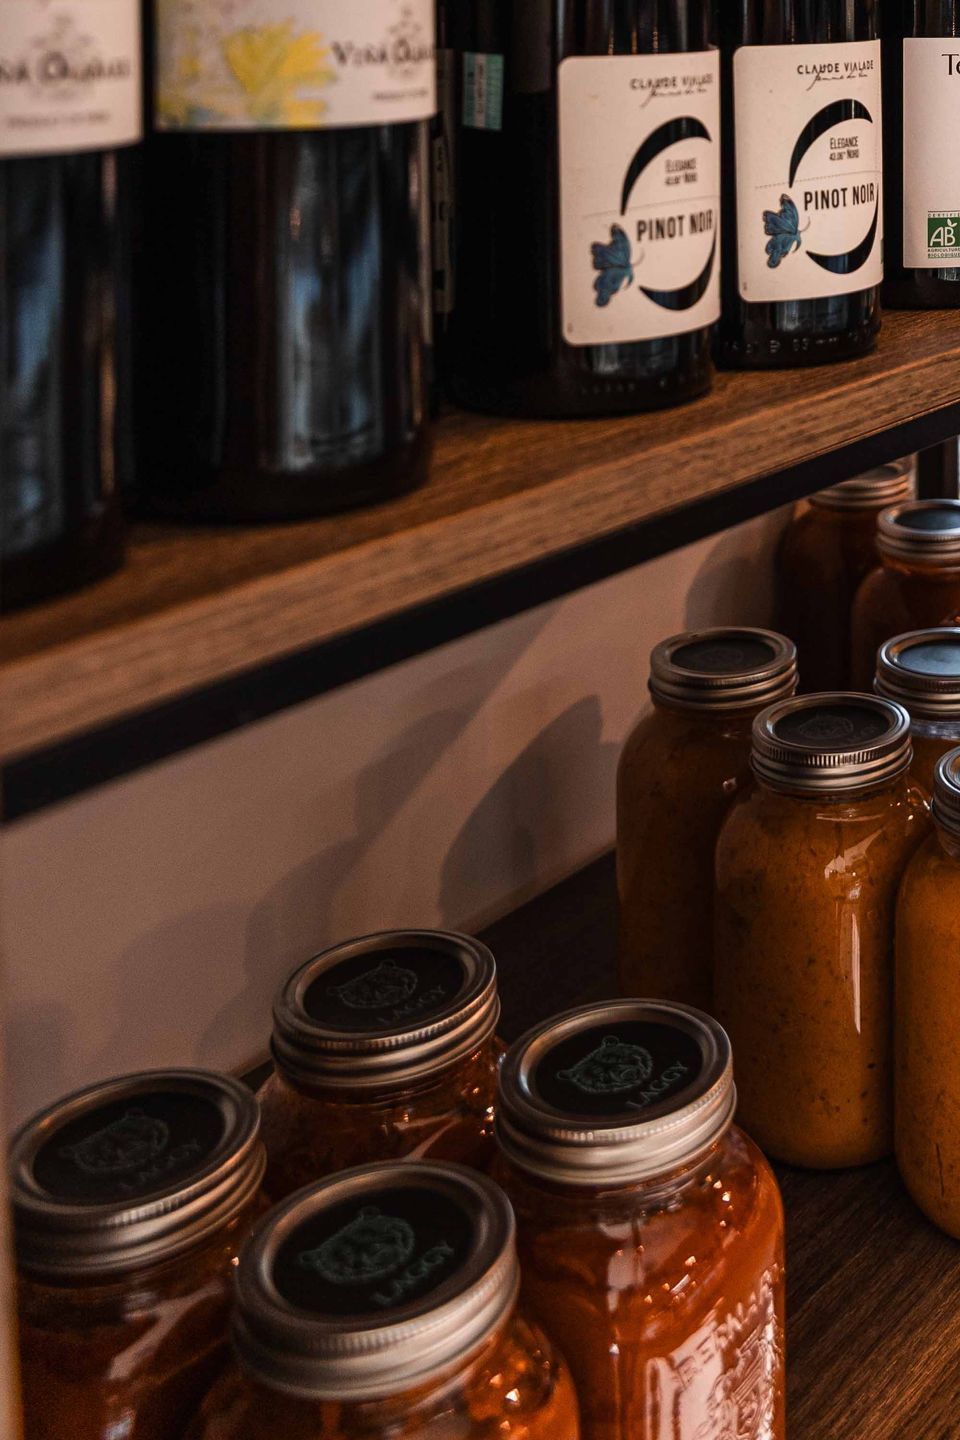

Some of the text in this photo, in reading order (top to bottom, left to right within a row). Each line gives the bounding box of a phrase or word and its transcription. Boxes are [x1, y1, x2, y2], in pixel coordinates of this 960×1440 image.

[797, 60, 874, 74] CLAUDE VIALADE
[804, 182, 875, 211] PINOT NOIR
[636, 210, 713, 242] PINOT NOIR
[930, 226, 955, 246] AB
[626, 1062, 689, 1109] LAGGY
[372, 1243, 455, 1306] LAGGY
